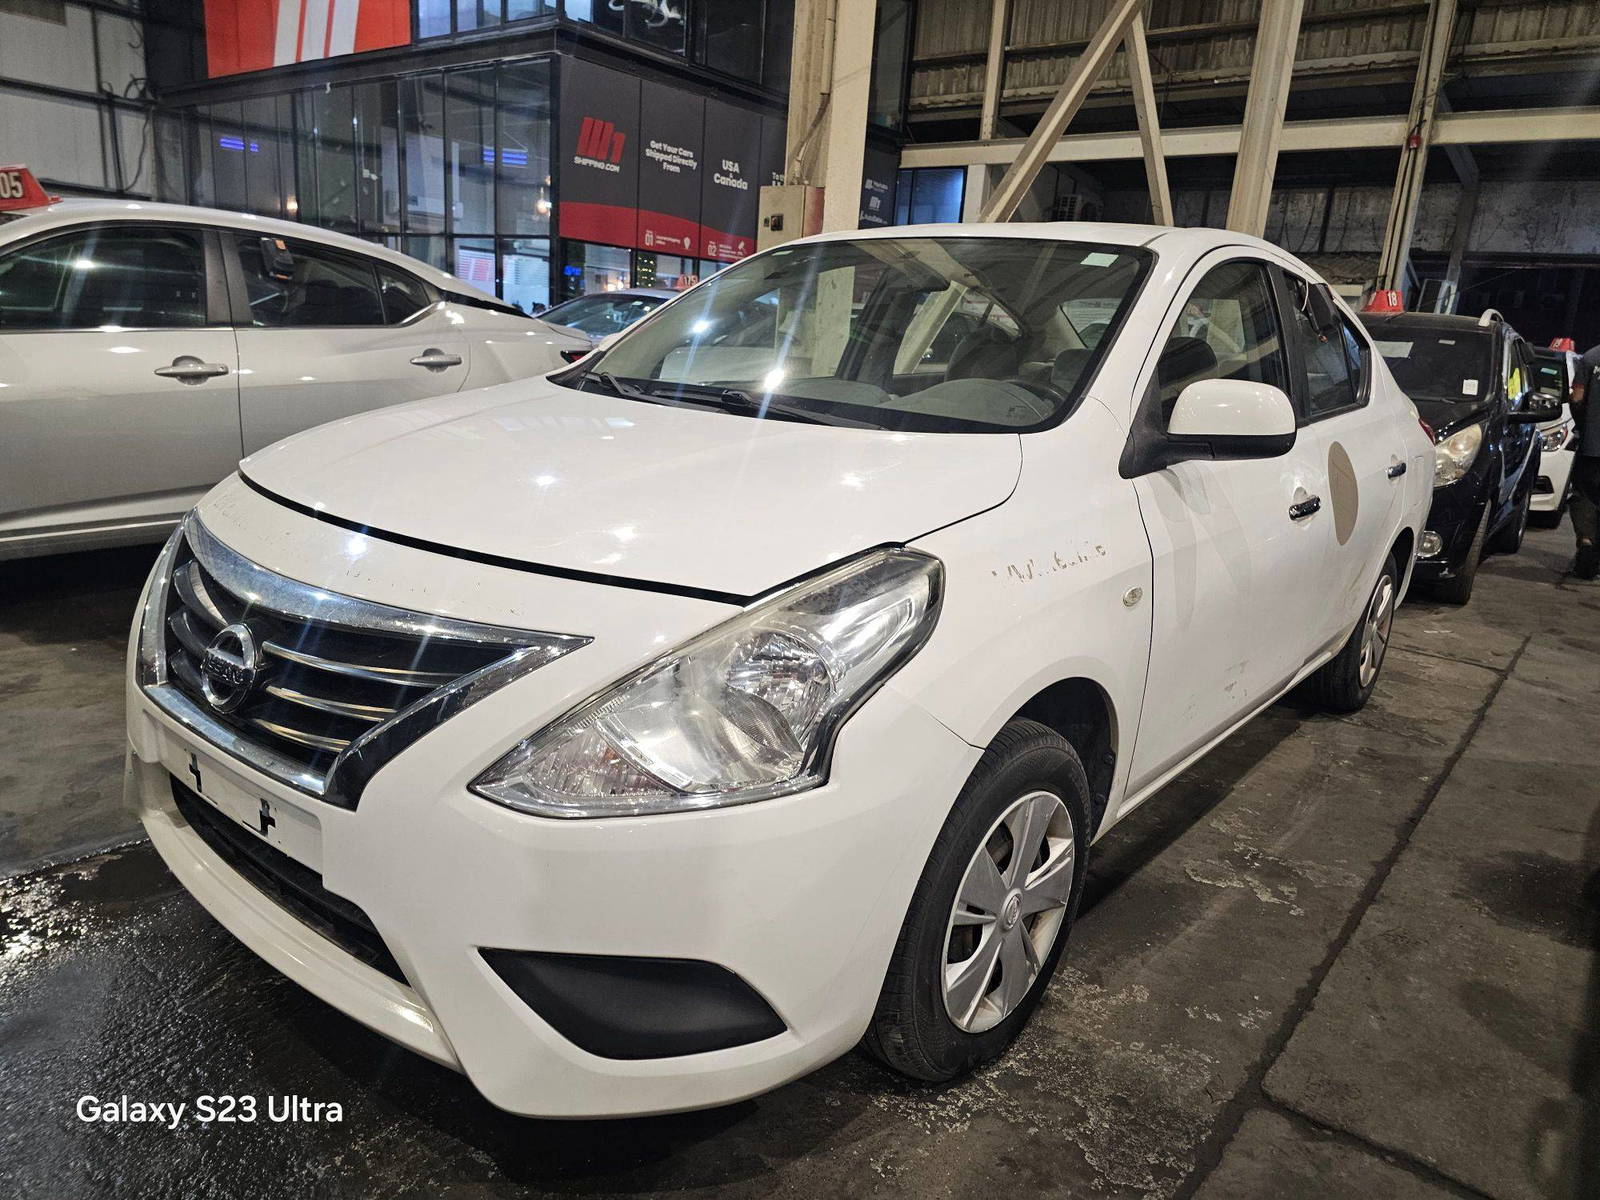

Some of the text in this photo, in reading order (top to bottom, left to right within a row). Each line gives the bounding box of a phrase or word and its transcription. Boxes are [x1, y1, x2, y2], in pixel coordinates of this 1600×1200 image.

[650, 140, 694, 158] Get Your Cars
[574, 156, 620, 173] SHIPPING.COM
[645, 148, 698, 170] Shipped Directly
[722, 159, 740, 174] USA
[662, 162, 681, 173] From
[713, 173, 748, 190] Canada
[645, 233, 654, 247] 01
[708, 244, 717, 257] 02
[1387, 291, 1398, 307] 18
